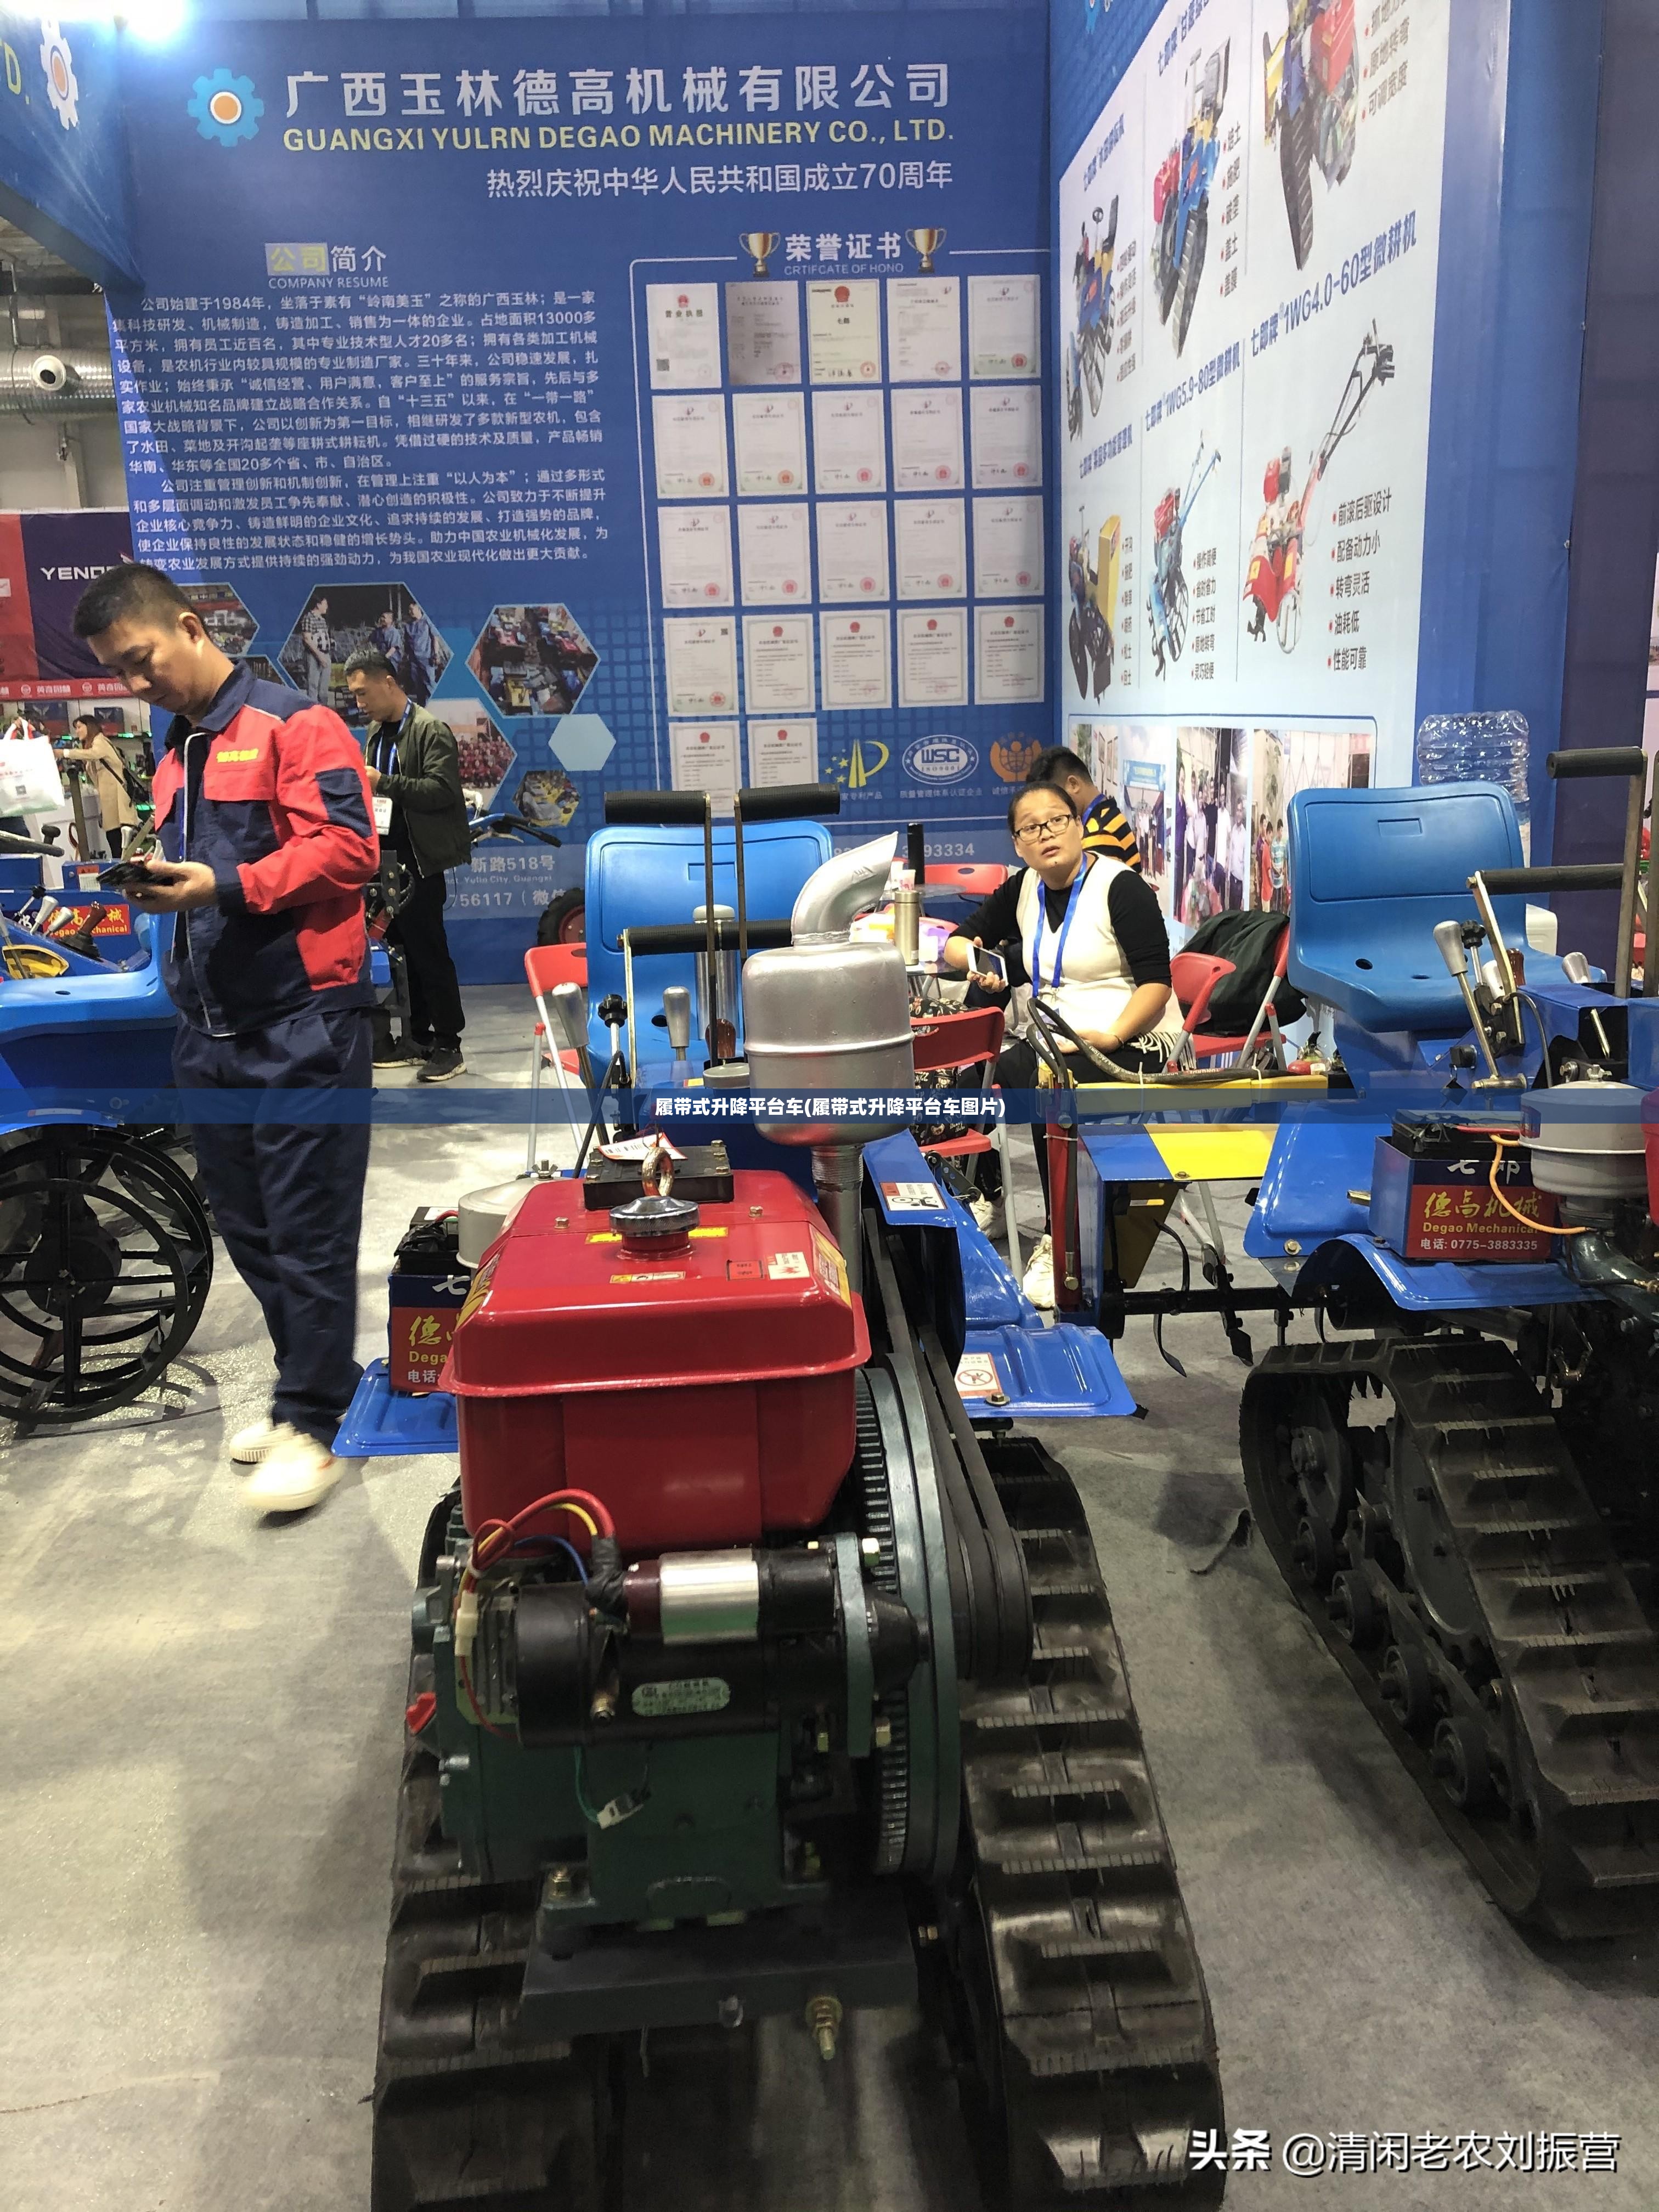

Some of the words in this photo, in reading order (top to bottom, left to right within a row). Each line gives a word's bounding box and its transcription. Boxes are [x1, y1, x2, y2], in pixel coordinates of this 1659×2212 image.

[286, 63, 950, 119] 广西玉林德高机械有限公司
[284, 128, 424, 151] GUANGXI
[432, 127, 531, 150] YULRN
[539, 125, 641, 149] DEGAO
[650, 121, 820, 146] MACHINERY
[829, 120, 885, 144] CO.,
[894, 119, 954, 142] LTD.
[487, 161, 953, 198] 热烈庆祝中华人民共和国成立70周年
[271, 245, 387, 274] 公司简介
[785, 232, 902, 262] 荣誉证书
[269, 277, 332, 289] COMPANY
[337, 276, 388, 289] RESUME
[784, 264, 848, 275] CRTIFCATE
[852, 264, 866, 274] OF
[870, 263, 904, 273] HONO
[1338, 487, 1392, 527] 前滚后驱设计
[1337, 529, 1380, 563] 配备动力小
[1335, 571, 1370, 599] 转弯灵活
[1334, 610, 1359, 635] 油耗低
[1334, 646, 1367, 672] 性能可靠
[1424, 1189, 1542, 1219] 德高机械
[1423, 1223, 1463, 1234] Degao
[1421, 1238, 1448, 1250] 电话:
[1451, 1239, 1538, 1251] 0775-3883335
